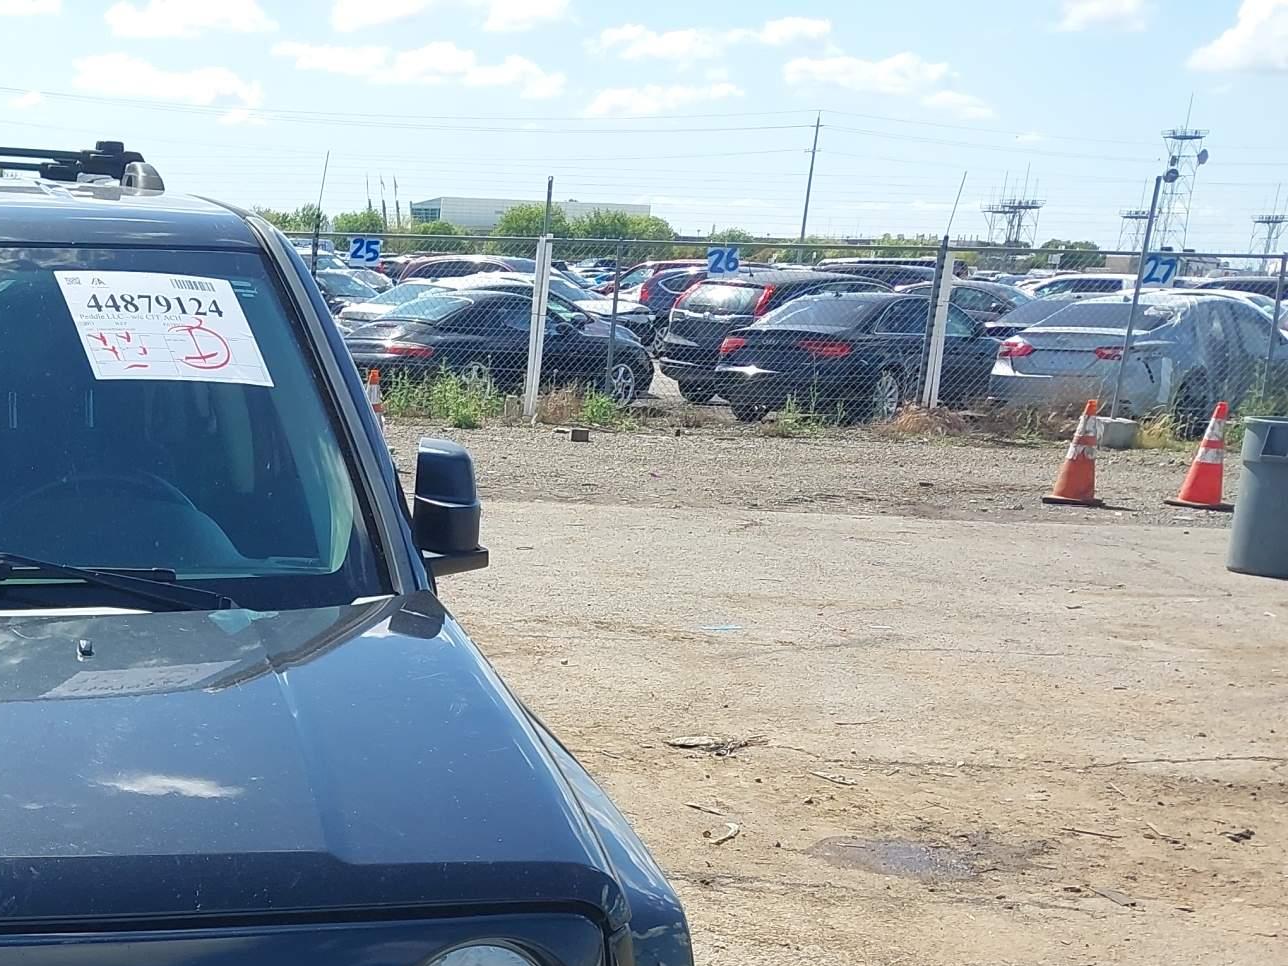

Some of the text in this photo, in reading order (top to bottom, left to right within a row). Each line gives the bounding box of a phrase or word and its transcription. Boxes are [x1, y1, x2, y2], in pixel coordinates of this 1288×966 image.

[351, 238, 379, 261] 25
[708, 246, 738, 273] 26
[1143, 255, 1176, 284] 27
[87, 293, 223, 317] 44879124
